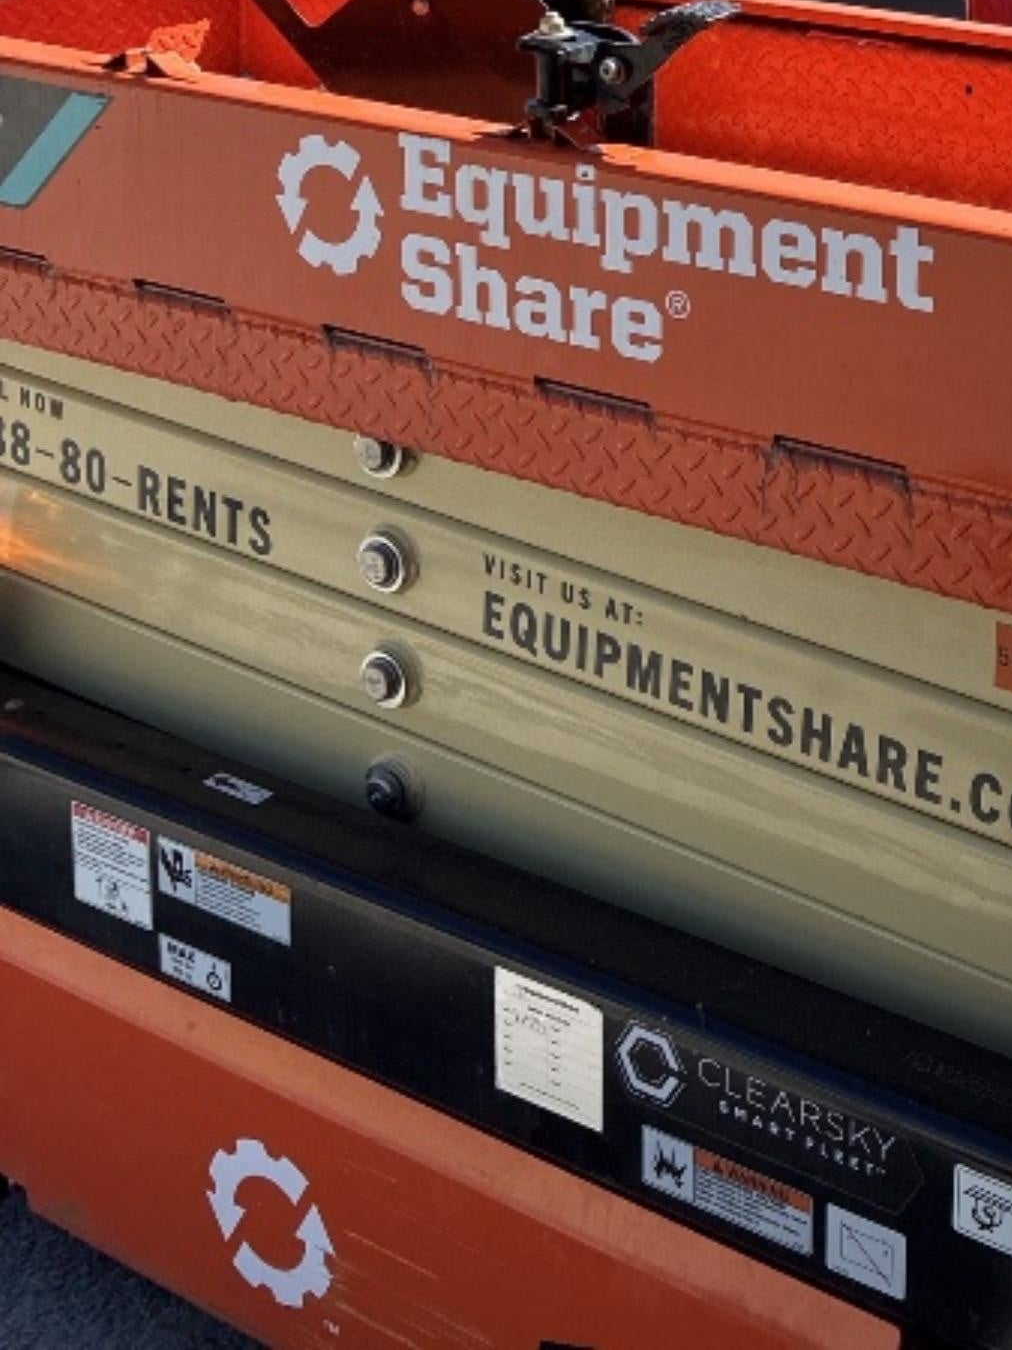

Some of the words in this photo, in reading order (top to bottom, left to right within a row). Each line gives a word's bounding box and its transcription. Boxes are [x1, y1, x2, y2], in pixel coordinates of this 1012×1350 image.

[400, 134, 935, 314] Equipment
[20, 387, 63, 420] NOW
[483, 553, 547, 595] VISIT
[561, 581, 592, 611] US
[605, 597, 643, 626] AT:
[698, 1058, 896, 1162] CLEARSKY
